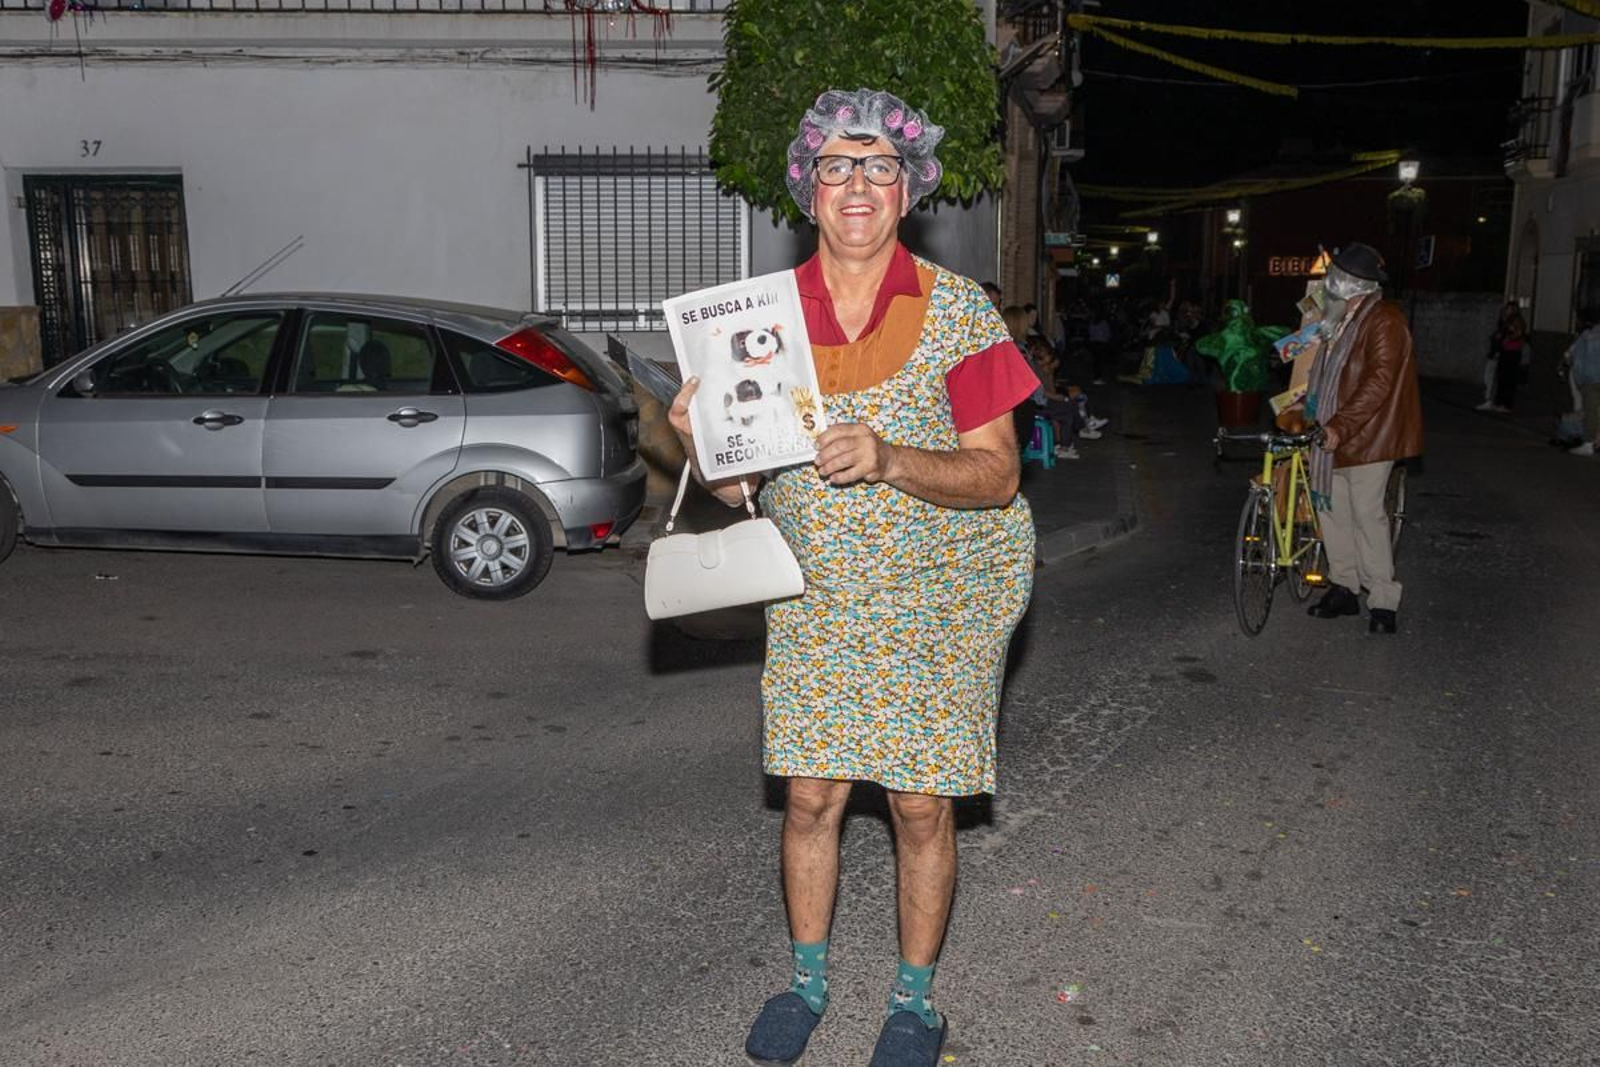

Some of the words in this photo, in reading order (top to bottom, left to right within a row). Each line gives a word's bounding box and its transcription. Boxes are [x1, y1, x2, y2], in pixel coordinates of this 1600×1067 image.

[80, 139, 102, 157] 37
[681, 309, 698, 325] SE
[700, 297, 743, 320] BUSCA
[745, 296, 754, 310] A
[727, 433, 744, 449] SE
